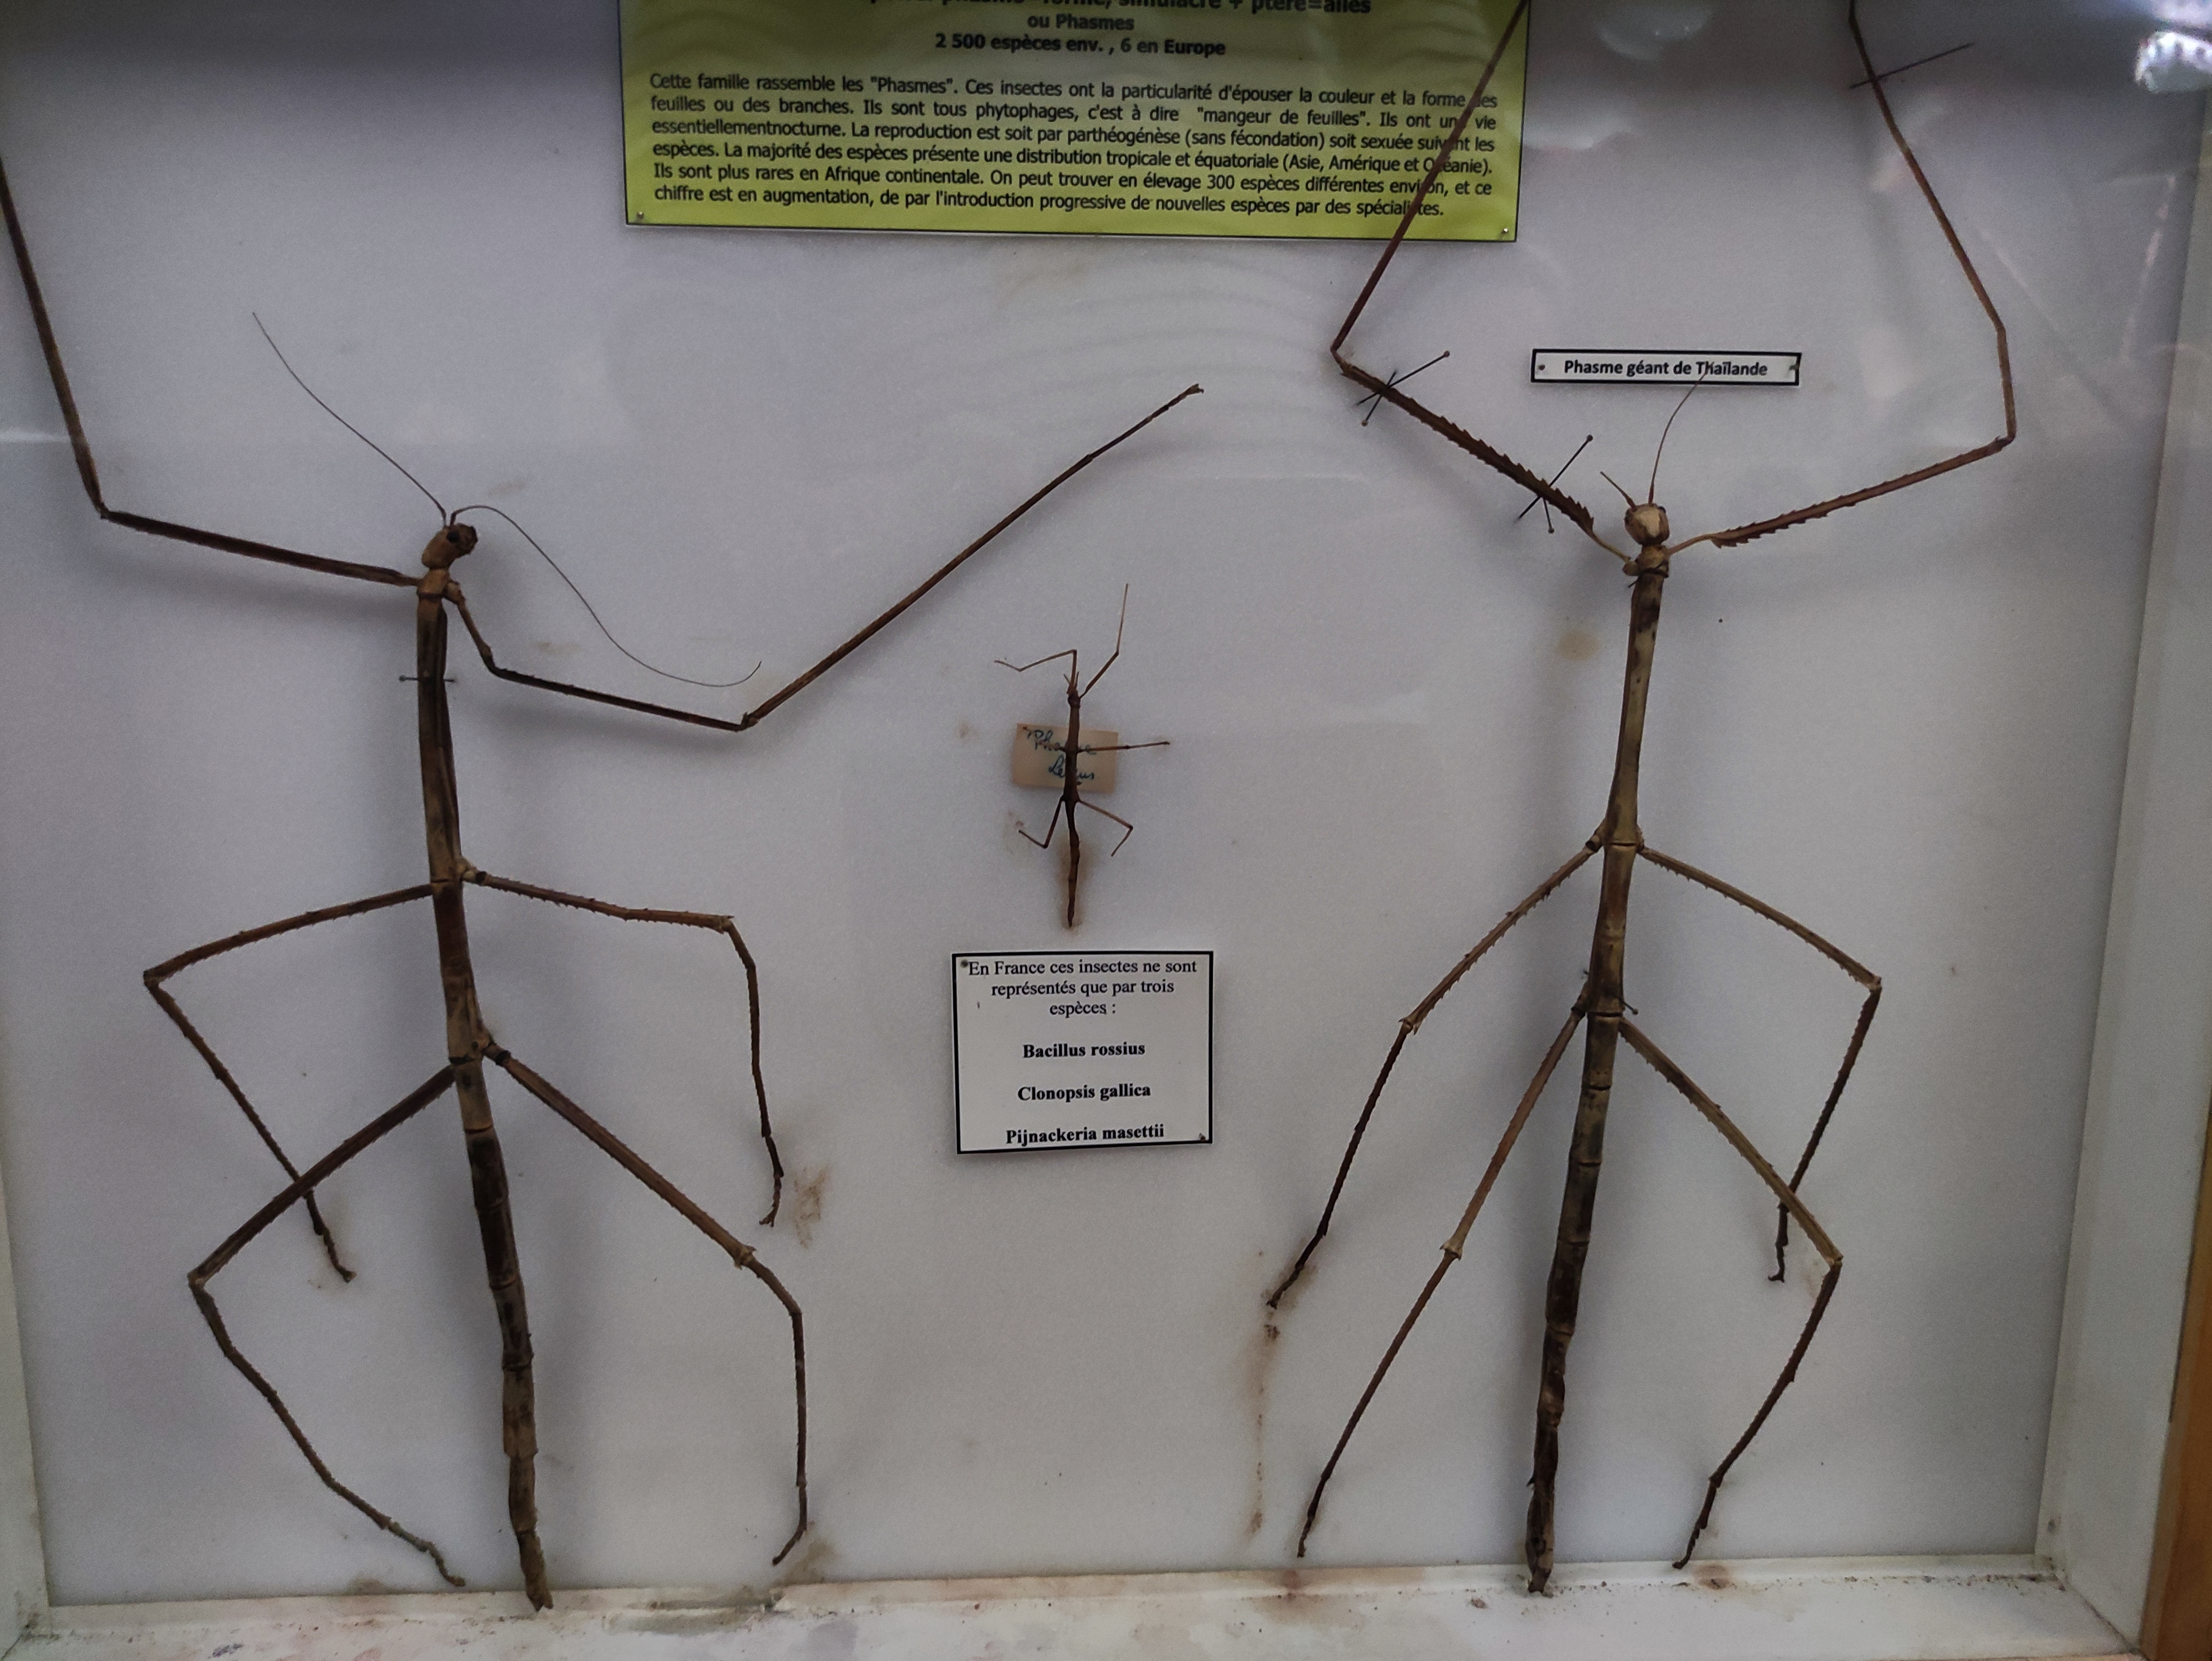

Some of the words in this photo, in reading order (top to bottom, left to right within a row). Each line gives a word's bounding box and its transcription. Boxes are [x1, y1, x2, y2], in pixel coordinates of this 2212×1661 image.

[1027, 15, 1050, 28] ou
[1056, 13, 1134, 31] Phasmes
[935, 32, 947, 48] 2
[951, 33, 986, 49] 500
[990, 33, 1061, 54] espèces
[1066, 39, 1104, 52] env.
[1120, 37, 1132, 53] 6
[1137, 41, 1159, 53] en
[1164, 39, 1226, 58] Europe
[650, 73, 691, 89] Cette
[697, 73, 750, 90] famille
[756, 75, 835, 92] rassemble
[842, 75, 864, 92] les
[870, 76, 958, 94] "Phasmes".
[965, 78, 994, 95] Ces
[1000, 79, 1062, 97] insectes
[1069, 82, 1095, 98] ont
[1101, 81, 1115, 98] la
[1121, 83, 1212, 101] particularité
[1218, 84, 1294, 105] d'épouser
[1299, 87, 1312, 103] la
[1318, 88, 1375, 104] couleur
[1381, 90, 1396, 105] et
[1403, 89, 1416, 105] la
[1422, 90, 1466, 107] forme
[651, 95, 706, 111] feuilles
[713, 99, 734, 112] ou
[742, 96, 771, 113] des
[778, 97, 854, 114] branches.
[863, 99, 883, 115] Ils
[891, 100, 926, 116] sont
[933, 101, 967, 117] tous
[975, 101, 1079, 122] phytophages,
[1087, 104, 1124, 121] c'est
[1131, 103, 1141, 121] à
[1150, 105, 1180, 122] dire
[1197, 106, 1272, 127] "mangeur
[1279, 109, 1299, 125] de
[1307, 109, 1371, 127] feuilles".
[1379, 111, 1398, 127] Ils
[1405, 113, 1431, 128] ont
[1439, 116, 1467, 129] un
[1475, 115, 1496, 130] vie
[652, 118, 846, 137] essentiellementnocturne.
[851, 121, 870, 137] La
[874, 122, 972, 142] reproduction
[976, 125, 1001, 141] est
[1005, 125, 1033, 141] soit
[1037, 129, 1063, 145] par
[1067, 125, 1181, 147] parthéogénèse
[1185, 128, 1226, 148] (sans
[1230, 129, 1325, 151] fécondation)
[1329, 133, 1357, 149] soit
[1360, 133, 1414, 150] sexuée
[1417, 135, 1470, 151] suivnt
[1475, 136, 1496, 152] les
[652, 139, 719, 159] espèces.
[723, 142, 743, 157] La
[747, 141, 811, 162] majorité
[815, 143, 843, 159] des
[846, 143, 908, 163] espèces
[913, 144, 980, 164] présente
[984, 150, 1013, 163] une
[1016, 147, 1102, 165] distribution
[1106, 150, 1172, 169] tropicale
[1175, 152, 1191, 167] et
[1194, 150, 1279, 171] équatoriale
[1283, 153, 1324, 173] (Asie,
[1328, 154, 1401, 175] Amérique
[1404, 157, 1420, 172] et
[1423, 156, 1492, 177] Oéanie).
[653, 162, 673, 178] Ils
[678, 164, 713, 179] sont
[718, 163, 750, 183] plus
[755, 167, 794, 180] rares
[799, 168, 819, 181] en
[824, 165, 881, 186] Afrique
[885, 168, 984, 185] continentale.
[990, 168, 1012, 185] On
[1018, 171, 1053, 189] peut
[1058, 171, 1114, 188] trouver
[1118, 175, 1138, 188] en
[1142, 171, 1202, 192] élevage
[1206, 174, 1235, 190] 300
[1240, 173, 1300, 194] espèces
[1305, 175, 1384, 193] différentes
[1389, 178, 1449, 198] envion,
[1454, 180, 1470, 195] et
[1474, 183, 1493, 196] ce
[654, 184, 704, 201] chiffre
[708, 186, 733, 202] est
[737, 189, 757, 202] en
[763, 188, 874, 208] augmentation,
[880, 188, 899, 205] de
[905, 193, 930, 209] par
[936, 189, 1034, 208] l'introduction
[1040, 194, 1126, 212] progressive
[1130, 194, 1150, 210] de
[1156, 195, 1226, 212] nouvelles
[1230, 196, 1290, 216] espèces
[1295, 201, 1321, 217] par
[1325, 198, 1351, 214] des
[1356, 198, 1444, 218] spécialites.
[1564, 359, 1623, 374] Phasme
[1626, 359, 1670, 377] géant
[1673, 360, 1692, 375] de
[1695, 361, 1768, 376] Thaïlande
[968, 961, 990, 975] En
[994, 961, 1045, 975] France
[1050, 963, 1074, 974] ces
[1079, 959, 1138, 974] insectes
[1142, 963, 1161, 973] ne
[1165, 961, 1197, 973] sont
[991, 980, 1076, 999] représentés
[1080, 983, 1108, 997] que
[1112, 983, 1137, 997] par
[1140, 978, 1174, 993] trois
[1050, 1000, 1107, 1019] espèces
[1022, 1043, 1086, 1058] Bacillus
[1091, 1041, 1145, 1056] rossius
[1018, 1084, 1095, 1103] Clonopsis
[1100, 1083, 1151, 1102] gallica
[1006, 1126, 1097, 1146] Pijnackeria
[1102, 1123, 1164, 1140] masettii
